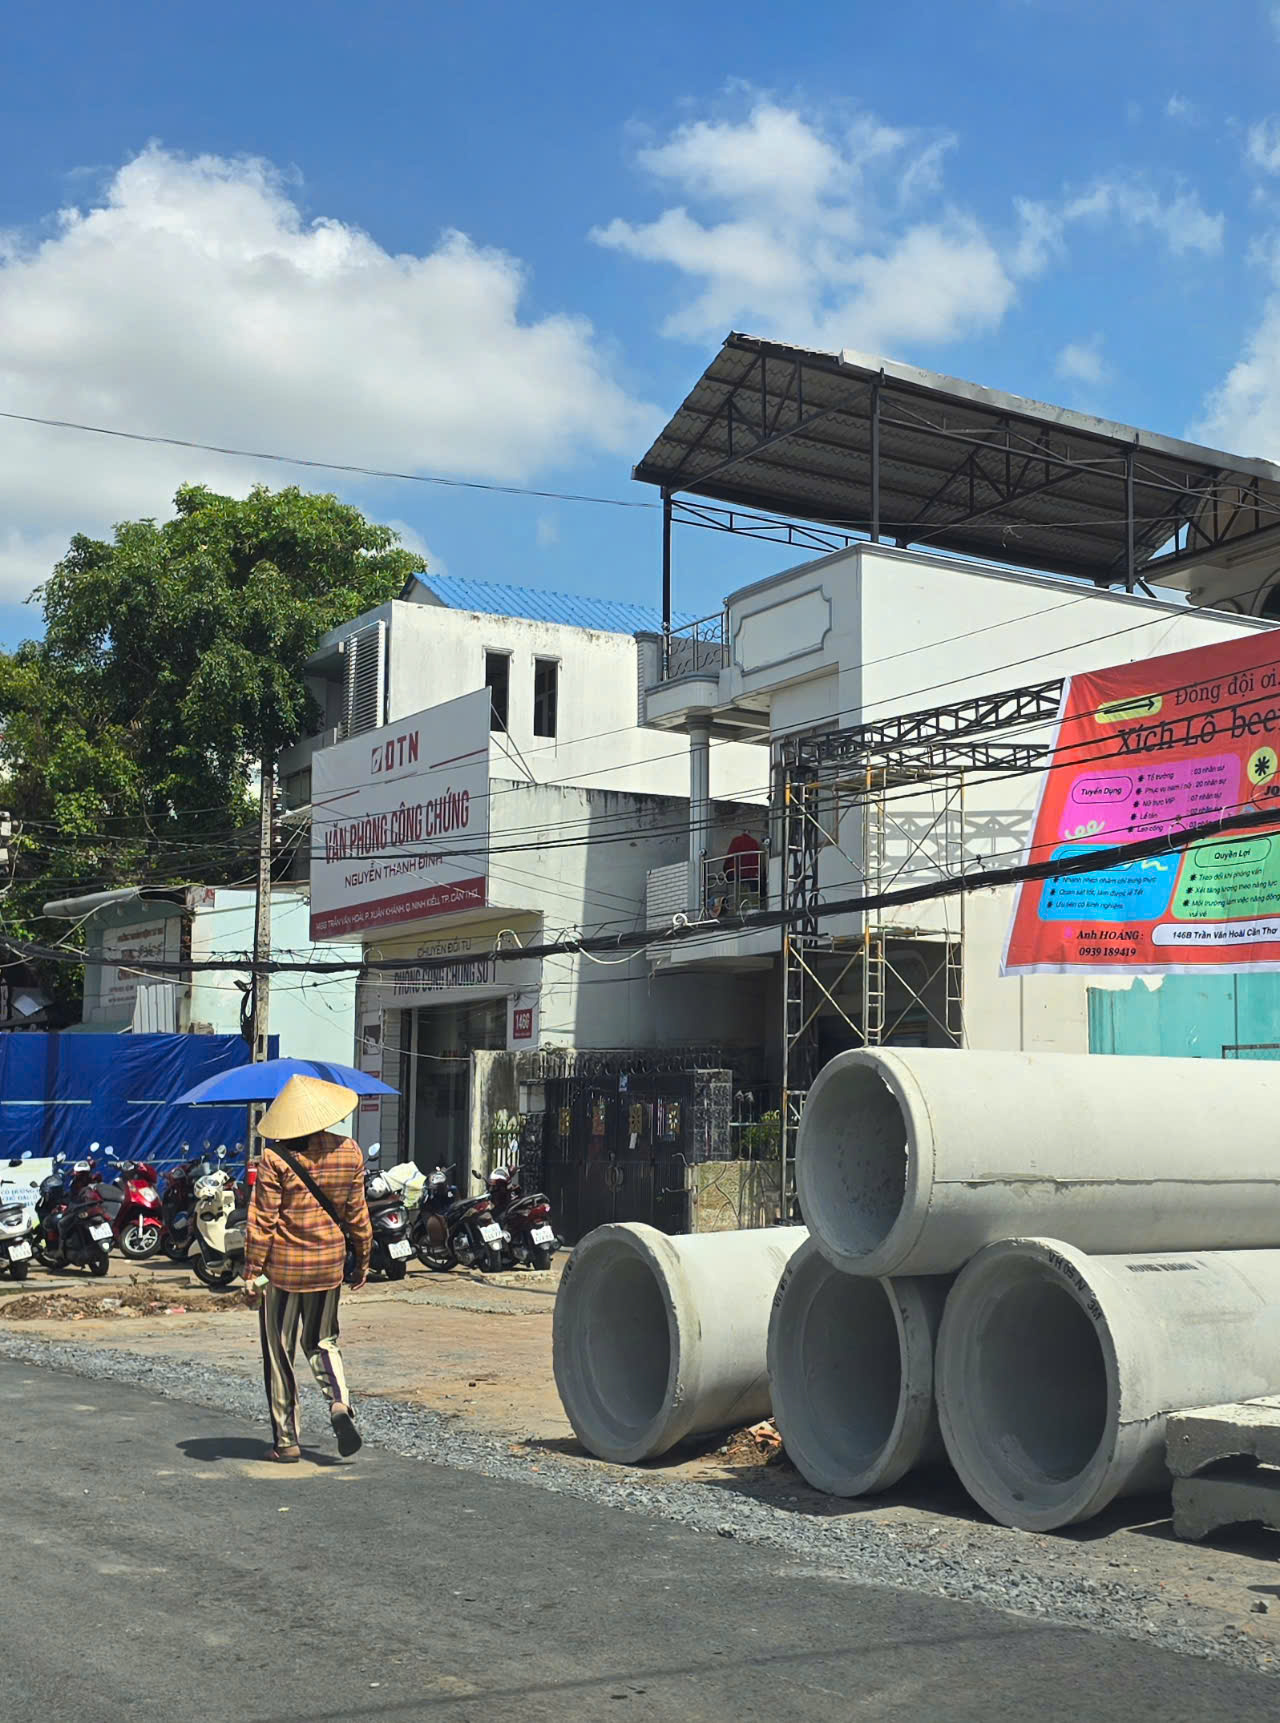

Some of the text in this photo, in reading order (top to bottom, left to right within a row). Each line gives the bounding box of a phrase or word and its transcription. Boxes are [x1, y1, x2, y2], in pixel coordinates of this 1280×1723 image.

[1228, 673, 1254, 697] đội
[1183, 714, 1217, 746] Lô
[385, 730, 419, 771] DTN
[1081, 787, 1122, 796] Tuyển Dụng
[325, 787, 470, 865] VĂN PHÒNG CÔNG CHỨNG
[1214, 850, 1237, 860] Quyền
[1077, 930, 1097, 939] Anh
[1173, 931, 1192, 939] 146B
[1193, 930, 1211, 939] Trần
[1213, 931, 1227, 939] Văn
[1246, 927, 1260, 937] Cần
[1262, 926, 1278, 935] Thơ
[1079, 947, 1137, 957] 0939 189419
[1088, 1300, 1101, 1320] 3M
